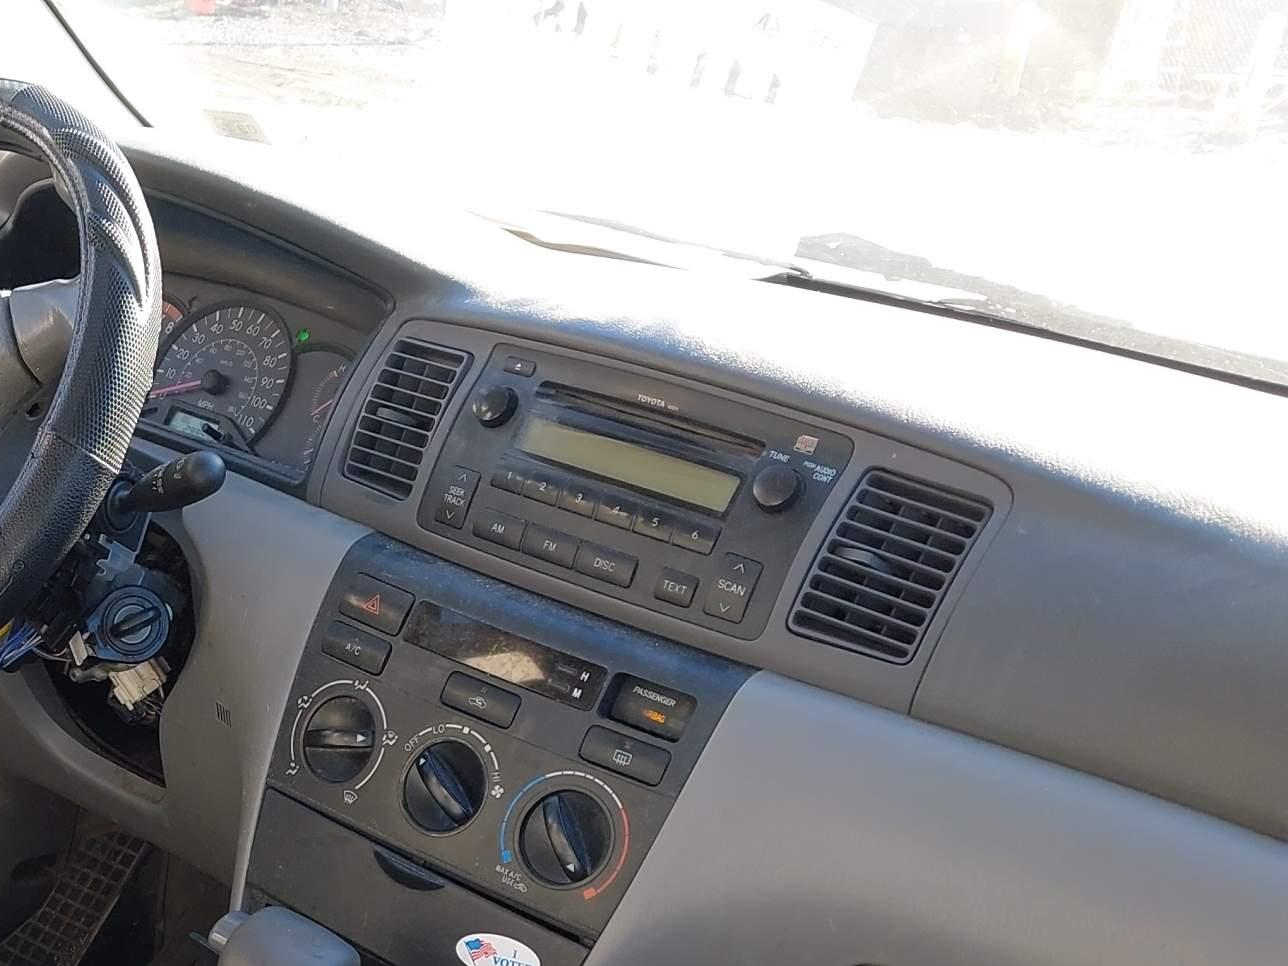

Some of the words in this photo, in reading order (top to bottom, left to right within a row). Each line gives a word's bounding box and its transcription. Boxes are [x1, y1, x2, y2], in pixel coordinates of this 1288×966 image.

[165, 322, 174, 334] 8
[210, 324, 223, 334] 40
[230, 320, 243, 331] 50
[246, 325, 260, 336] 60
[192, 333, 205, 344] 30
[259, 337, 272, 349] 70
[176, 350, 190, 360] 20
[263, 356, 277, 368] 80
[166, 368, 176, 379] 10
[260, 376, 274, 388] 90
[198, 398, 214, 411] MPH
[250, 396, 266, 408] 100
[638, 393, 665, 408] TOYOTA
[239, 414, 254, 427] 110
[768, 450, 790, 463] TUNE
[814, 464, 837, 476] AUDIO
[812, 472, 833, 483] CONT
[448, 485, 465, 497] SEEK
[539, 481, 547, 492] 2
[444, 494, 466, 507] TRACK
[576, 493, 584, 504] 3
[612, 506, 620, 514] 4
[652, 516, 660, 527] 5
[490, 522, 505, 534] AM
[692, 530, 699, 540] 6
[543, 540, 557, 552] FM
[593, 557, 616, 572] DISC
[663, 580, 688, 595] TEXT
[718, 578, 746, 597] SCAN
[344, 642, 362, 656] A/C
[580, 671, 590, 682] H
[572, 687, 582, 700] M
[632, 686, 676, 708] PASSENGER
[432, 724, 446, 735] LO
[404, 734, 420, 752] OFF
[492, 772, 501, 783] HI
[496, 864, 510, 876] MAX
[508, 871, 522, 881] A/C
[502, 876, 514, 887] USE
[512, 949, 517, 959] I
